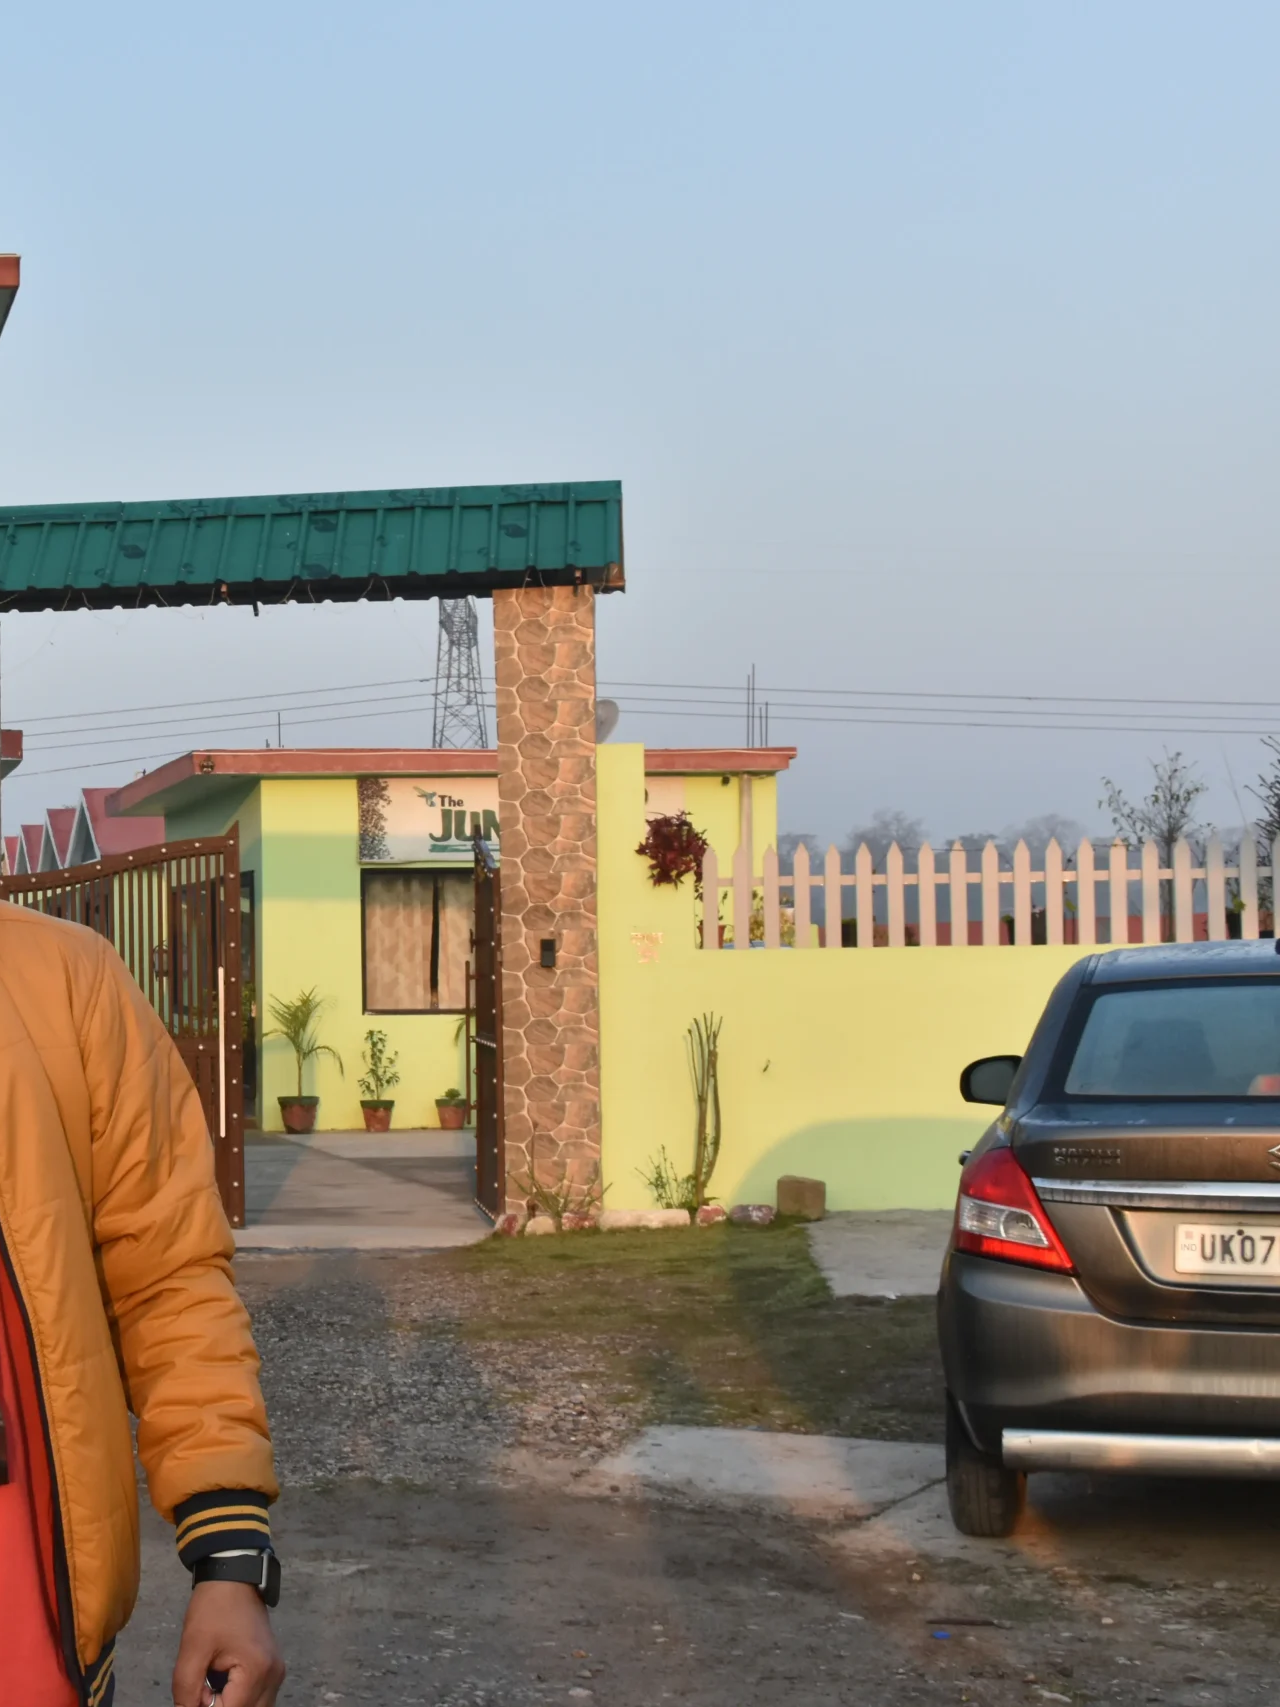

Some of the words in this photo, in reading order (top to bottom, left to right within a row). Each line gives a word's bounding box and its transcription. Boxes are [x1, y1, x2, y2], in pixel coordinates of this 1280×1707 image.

[438, 795, 464, 807] The
[1180, 1243, 1197, 1251] IND
[1200, 1233, 1276, 1264] UK07
